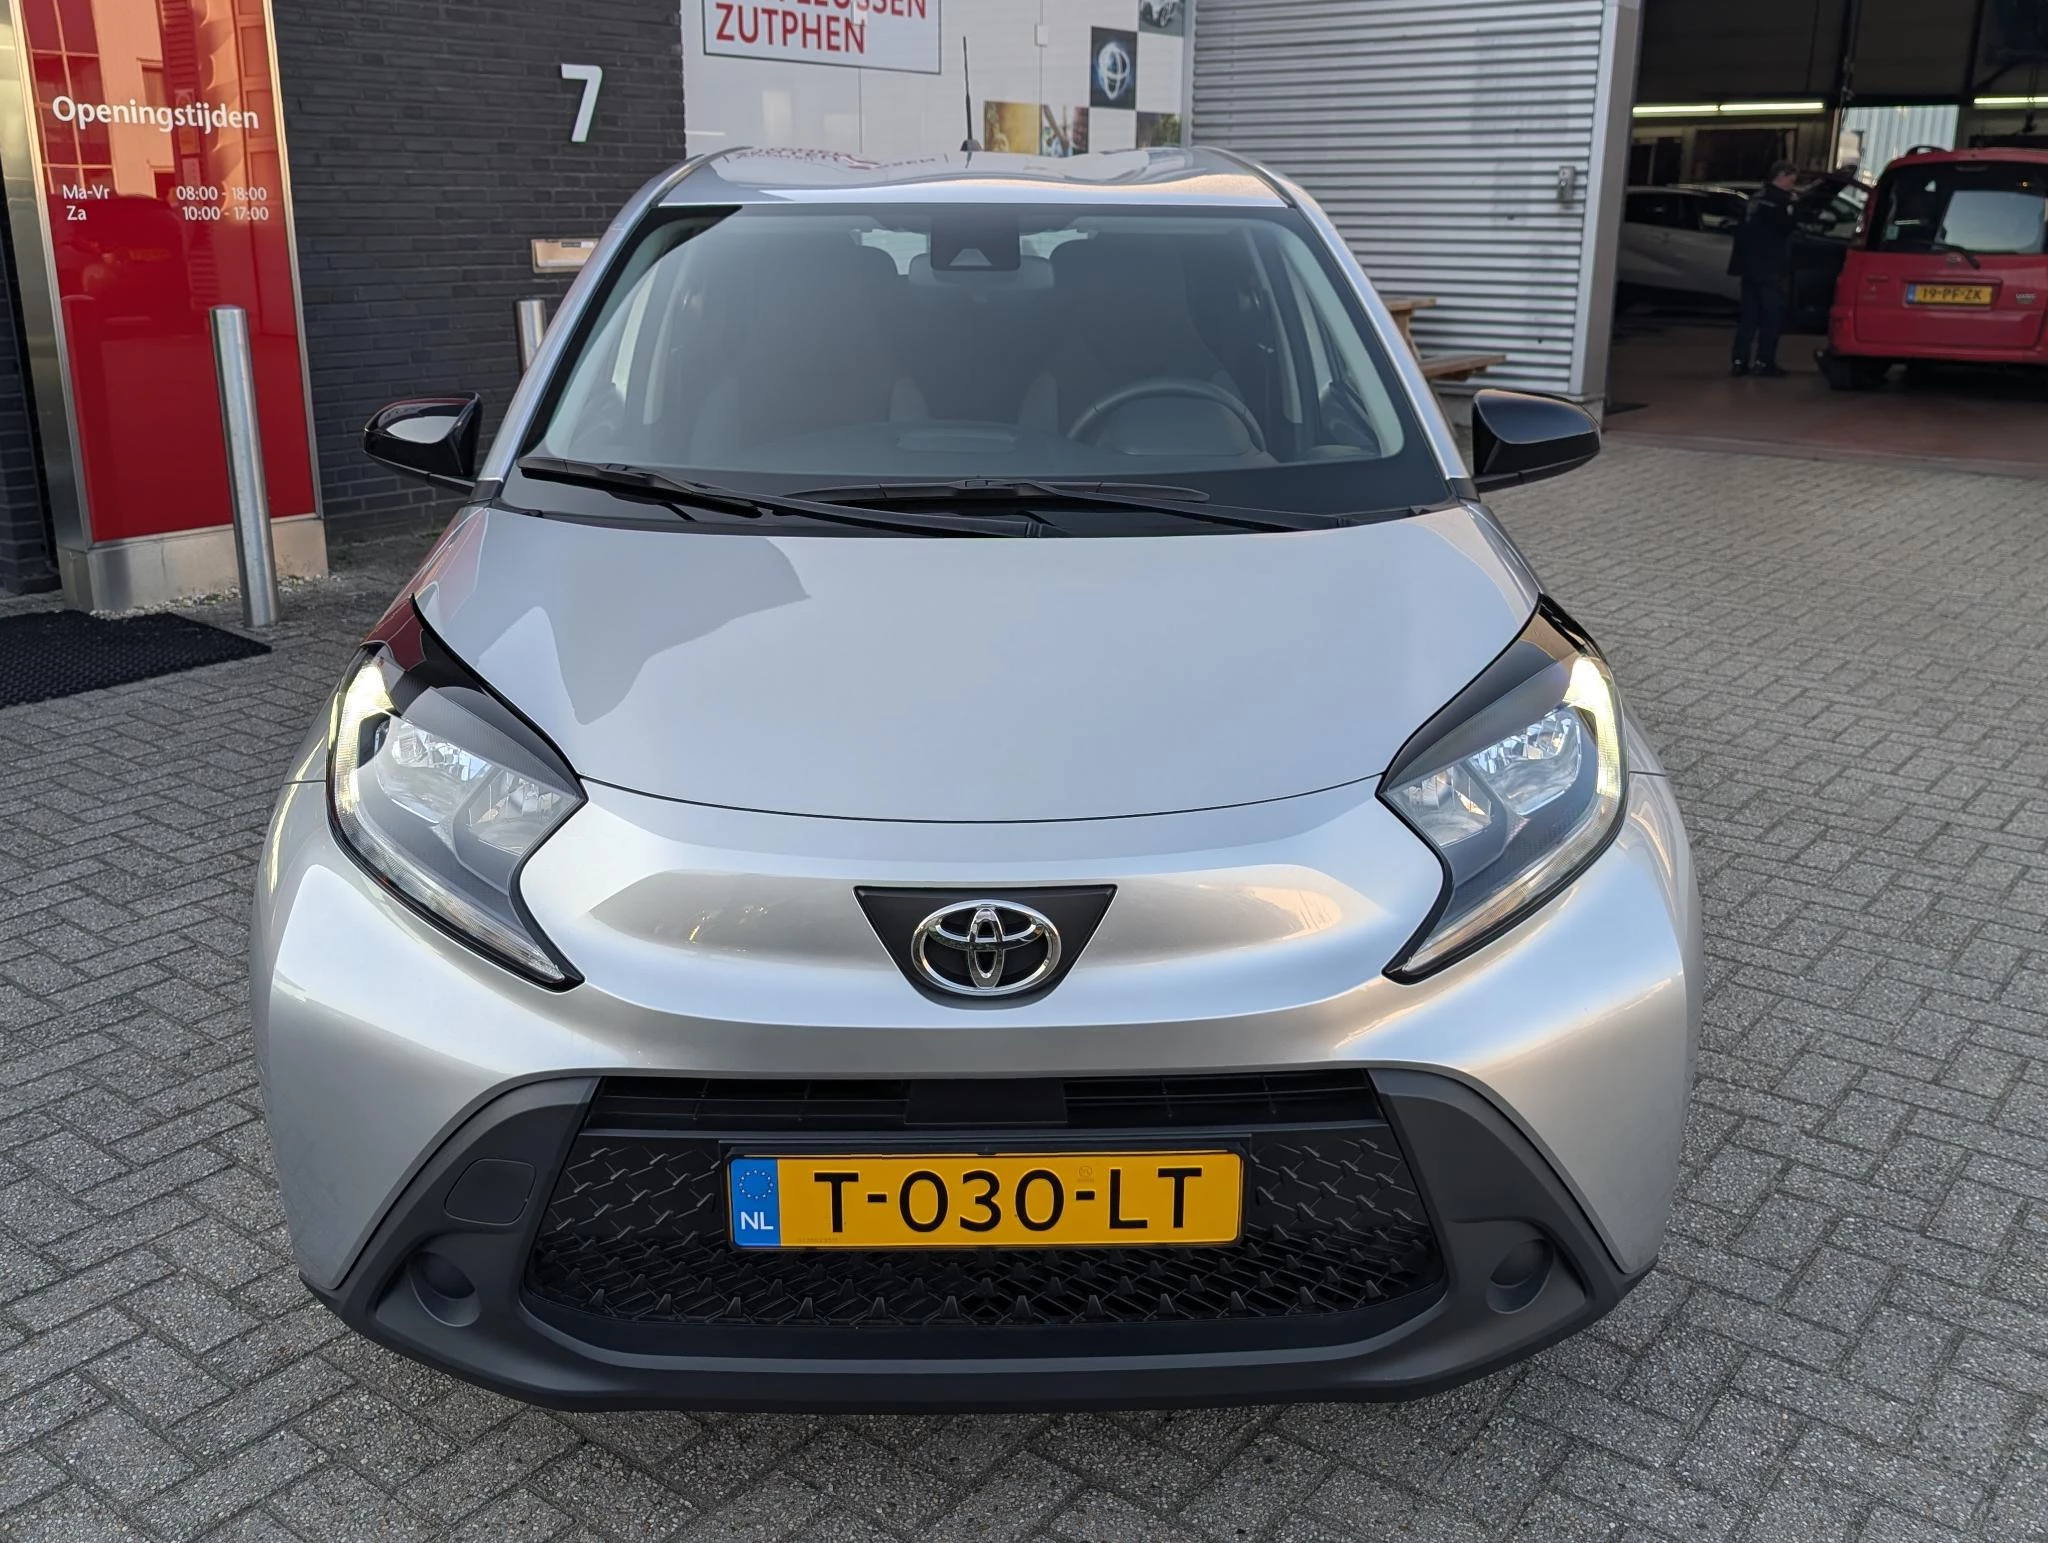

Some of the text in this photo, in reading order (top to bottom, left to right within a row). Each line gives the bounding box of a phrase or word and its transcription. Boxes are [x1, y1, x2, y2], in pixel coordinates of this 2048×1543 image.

[715, 3, 865, 54] ZUTPHEN
[52, 95, 260, 134] Openingstijden
[561, 63, 603, 143] 7
[62, 184, 110, 200] Ma-Vr
[176, 186, 218, 201] 08:00
[231, 186, 267, 201] 18:00
[66, 205, 87, 221] Za
[182, 206, 221, 221] 10:00
[234, 206, 269, 221] 17:00
[813, 1166, 1203, 1233] T-030-LT
[740, 1211, 774, 1231] NL
